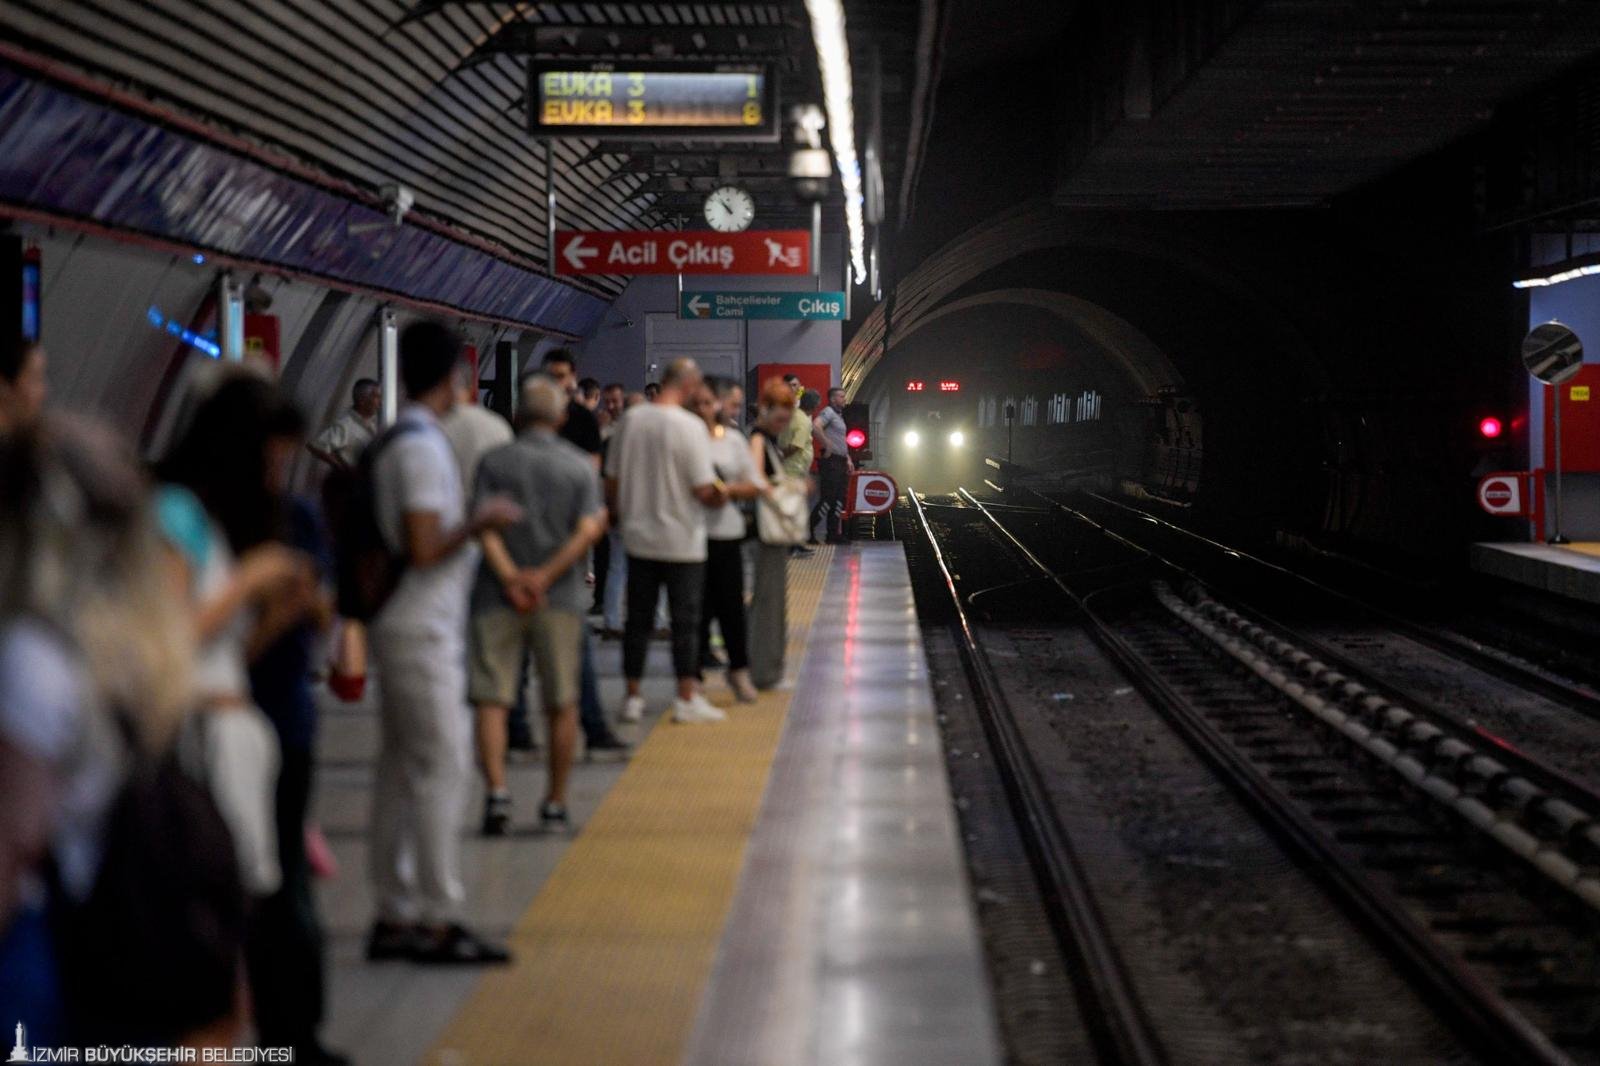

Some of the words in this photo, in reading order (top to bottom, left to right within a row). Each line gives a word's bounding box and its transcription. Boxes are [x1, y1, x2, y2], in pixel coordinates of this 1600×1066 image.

[543, 71, 613, 97] EVKA
[626, 71, 646, 97] 3
[746, 73, 758, 98] 1
[543, 100, 613, 124] EVKA
[626, 100, 646, 124] 3
[607, 240, 658, 265] Acil
[667, 240, 735, 269] Çıkış
[715, 295, 782, 306] Bahçelievler
[798, 298, 841, 317] Çıkış
[716, 306, 744, 317] Cami
